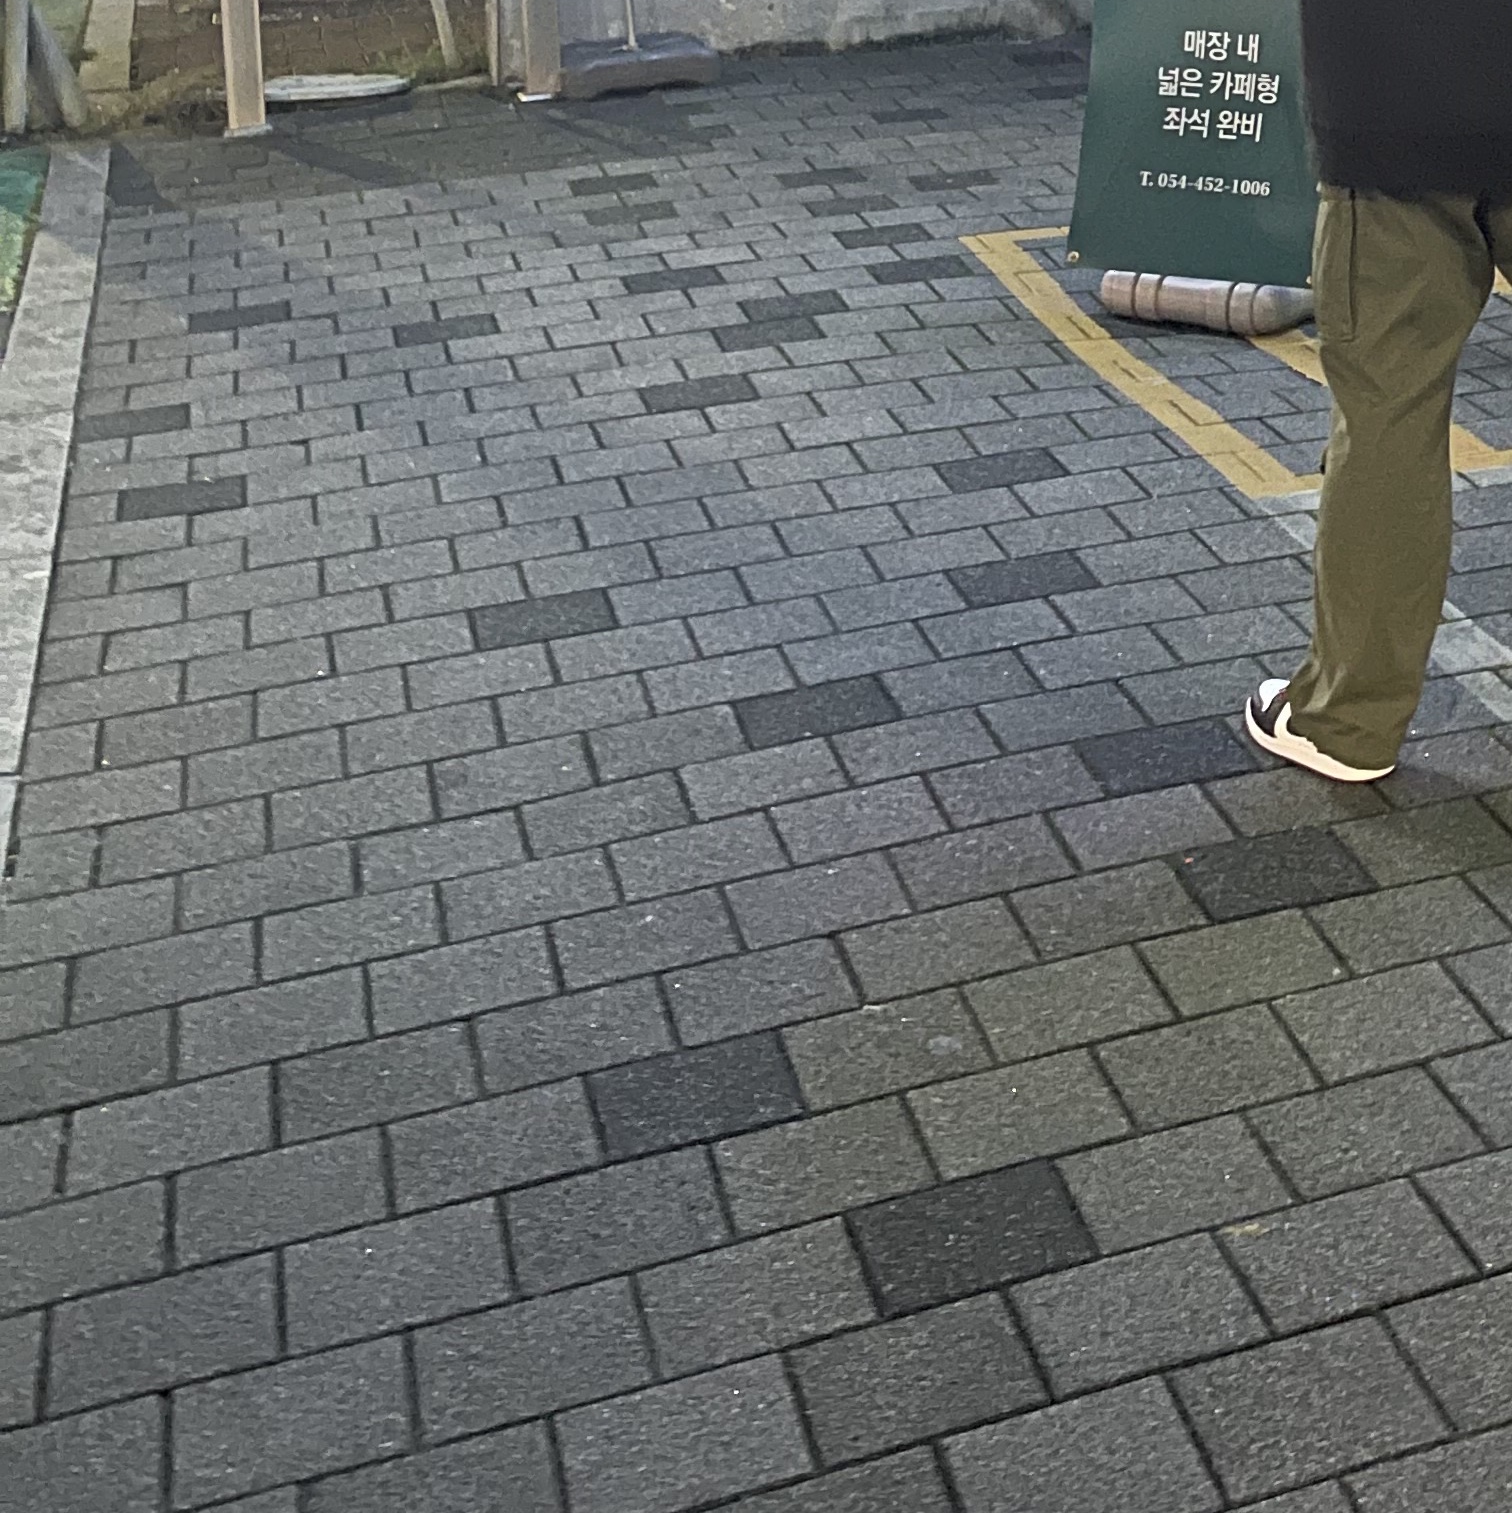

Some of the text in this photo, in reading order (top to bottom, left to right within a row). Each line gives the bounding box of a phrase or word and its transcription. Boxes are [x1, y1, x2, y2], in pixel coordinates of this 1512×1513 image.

[1183, 29, 1260, 64] 매장 내
[1157, 66, 1281, 105] 넓은 카페형
[1162, 106, 1264, 143] 좌석 완비
[1139, 170, 1271, 198] T. 054-452-1006
